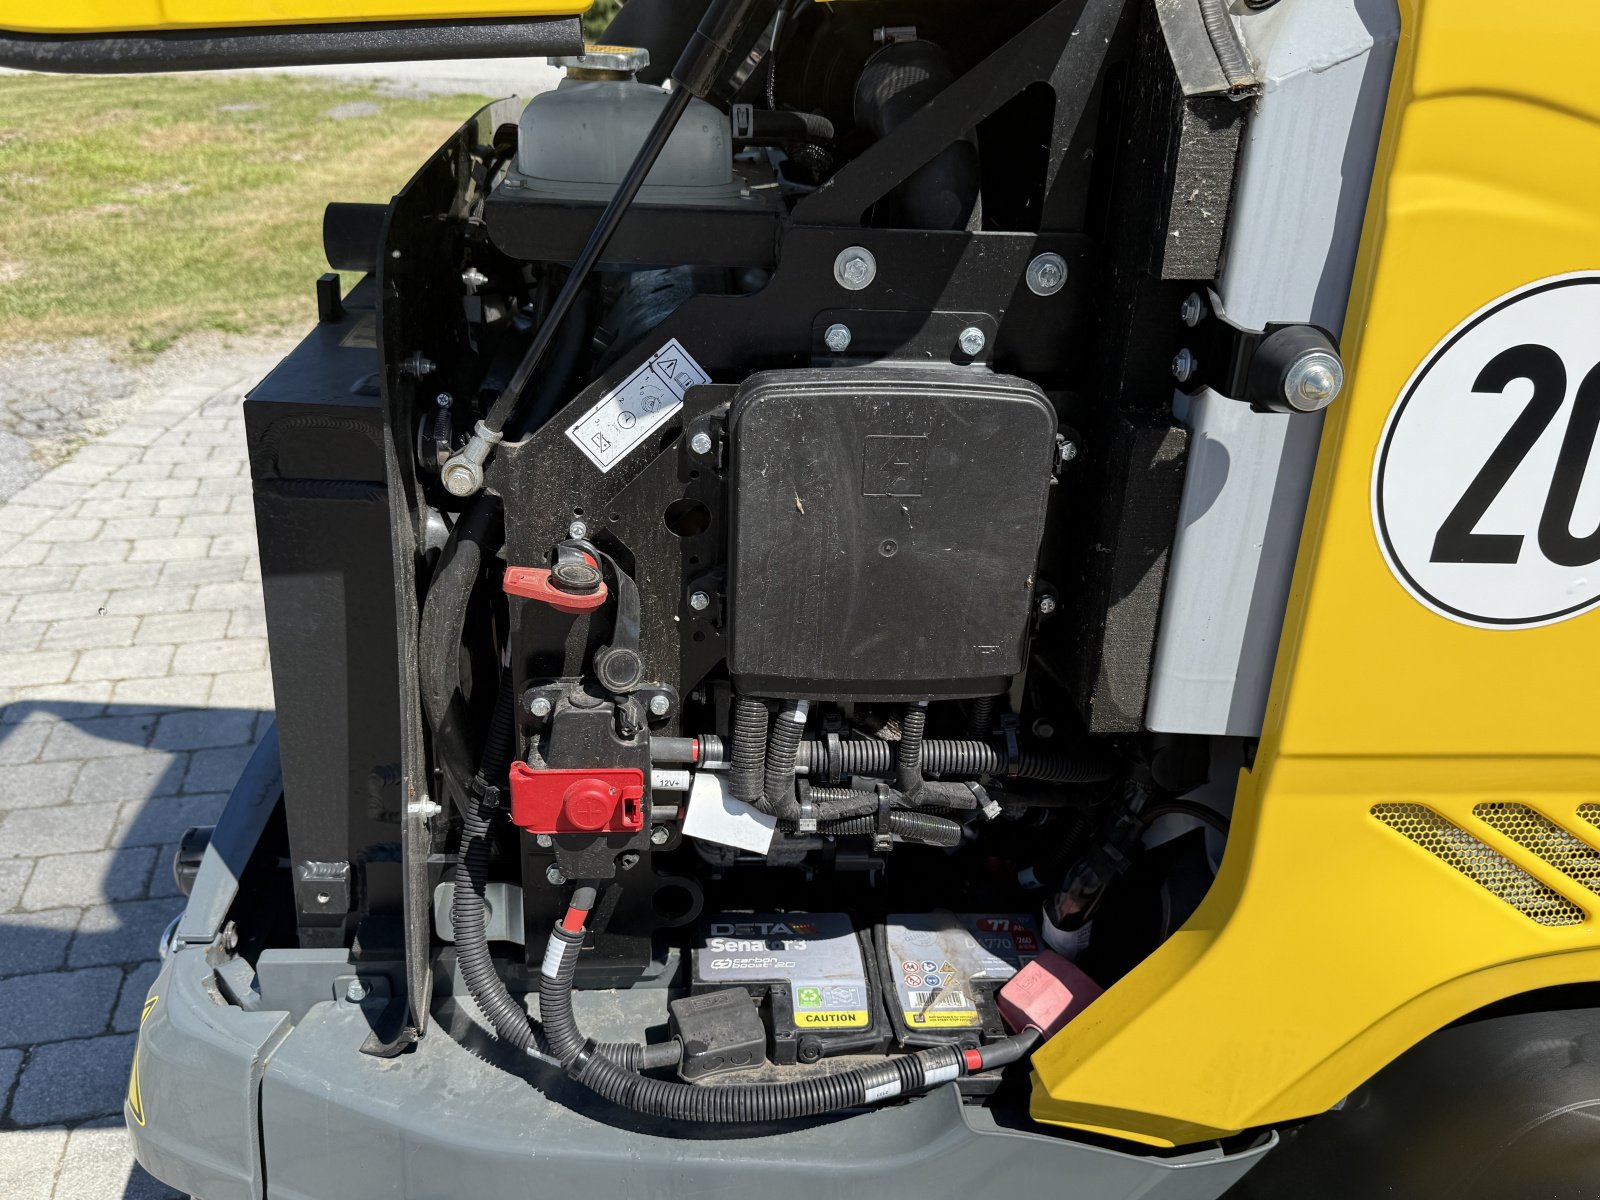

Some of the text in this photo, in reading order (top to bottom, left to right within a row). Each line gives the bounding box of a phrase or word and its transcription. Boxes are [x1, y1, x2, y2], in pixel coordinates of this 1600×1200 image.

[1429, 343, 1600, 567] 20
[660, 779, 680, 787] 12V+
[711, 923, 793, 936] DETA
[987, 919, 1010, 931] 77
[805, 1014, 857, 1023] CAUTION
